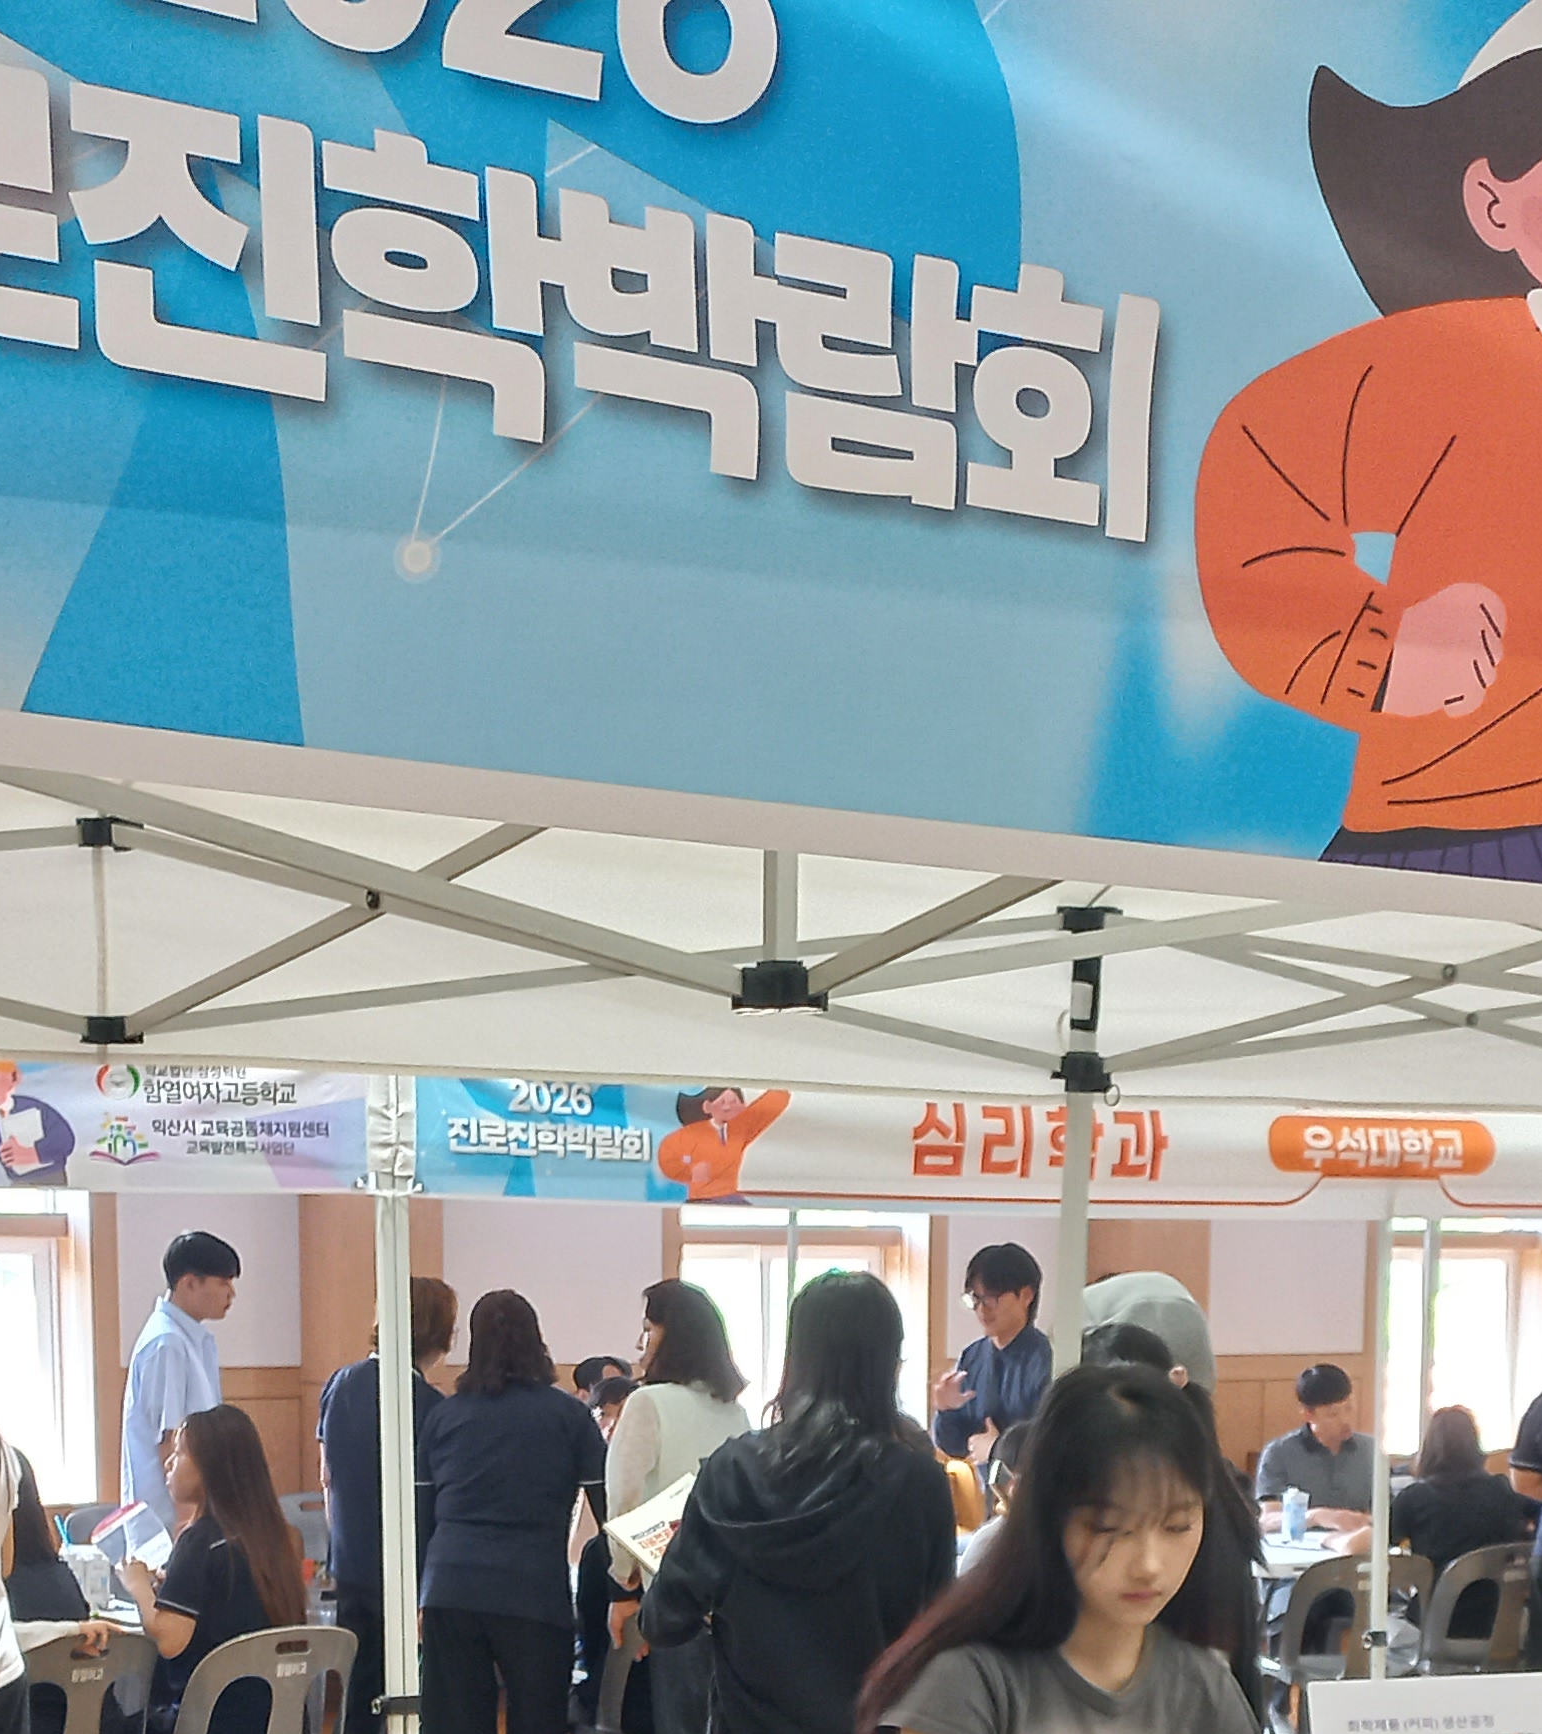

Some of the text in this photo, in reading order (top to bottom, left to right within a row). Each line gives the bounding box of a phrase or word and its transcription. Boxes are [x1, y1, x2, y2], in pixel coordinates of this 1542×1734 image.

[143, 1079, 297, 1106] 함열여자고등학교
[508, 1078, 595, 1116] 2026
[152, 1119, 330, 1139] 익산시 교육공동체지원센터
[447, 1116, 652, 1162] 진로진학박람회
[1302, 1124, 1464, 1170] 우석대학교
